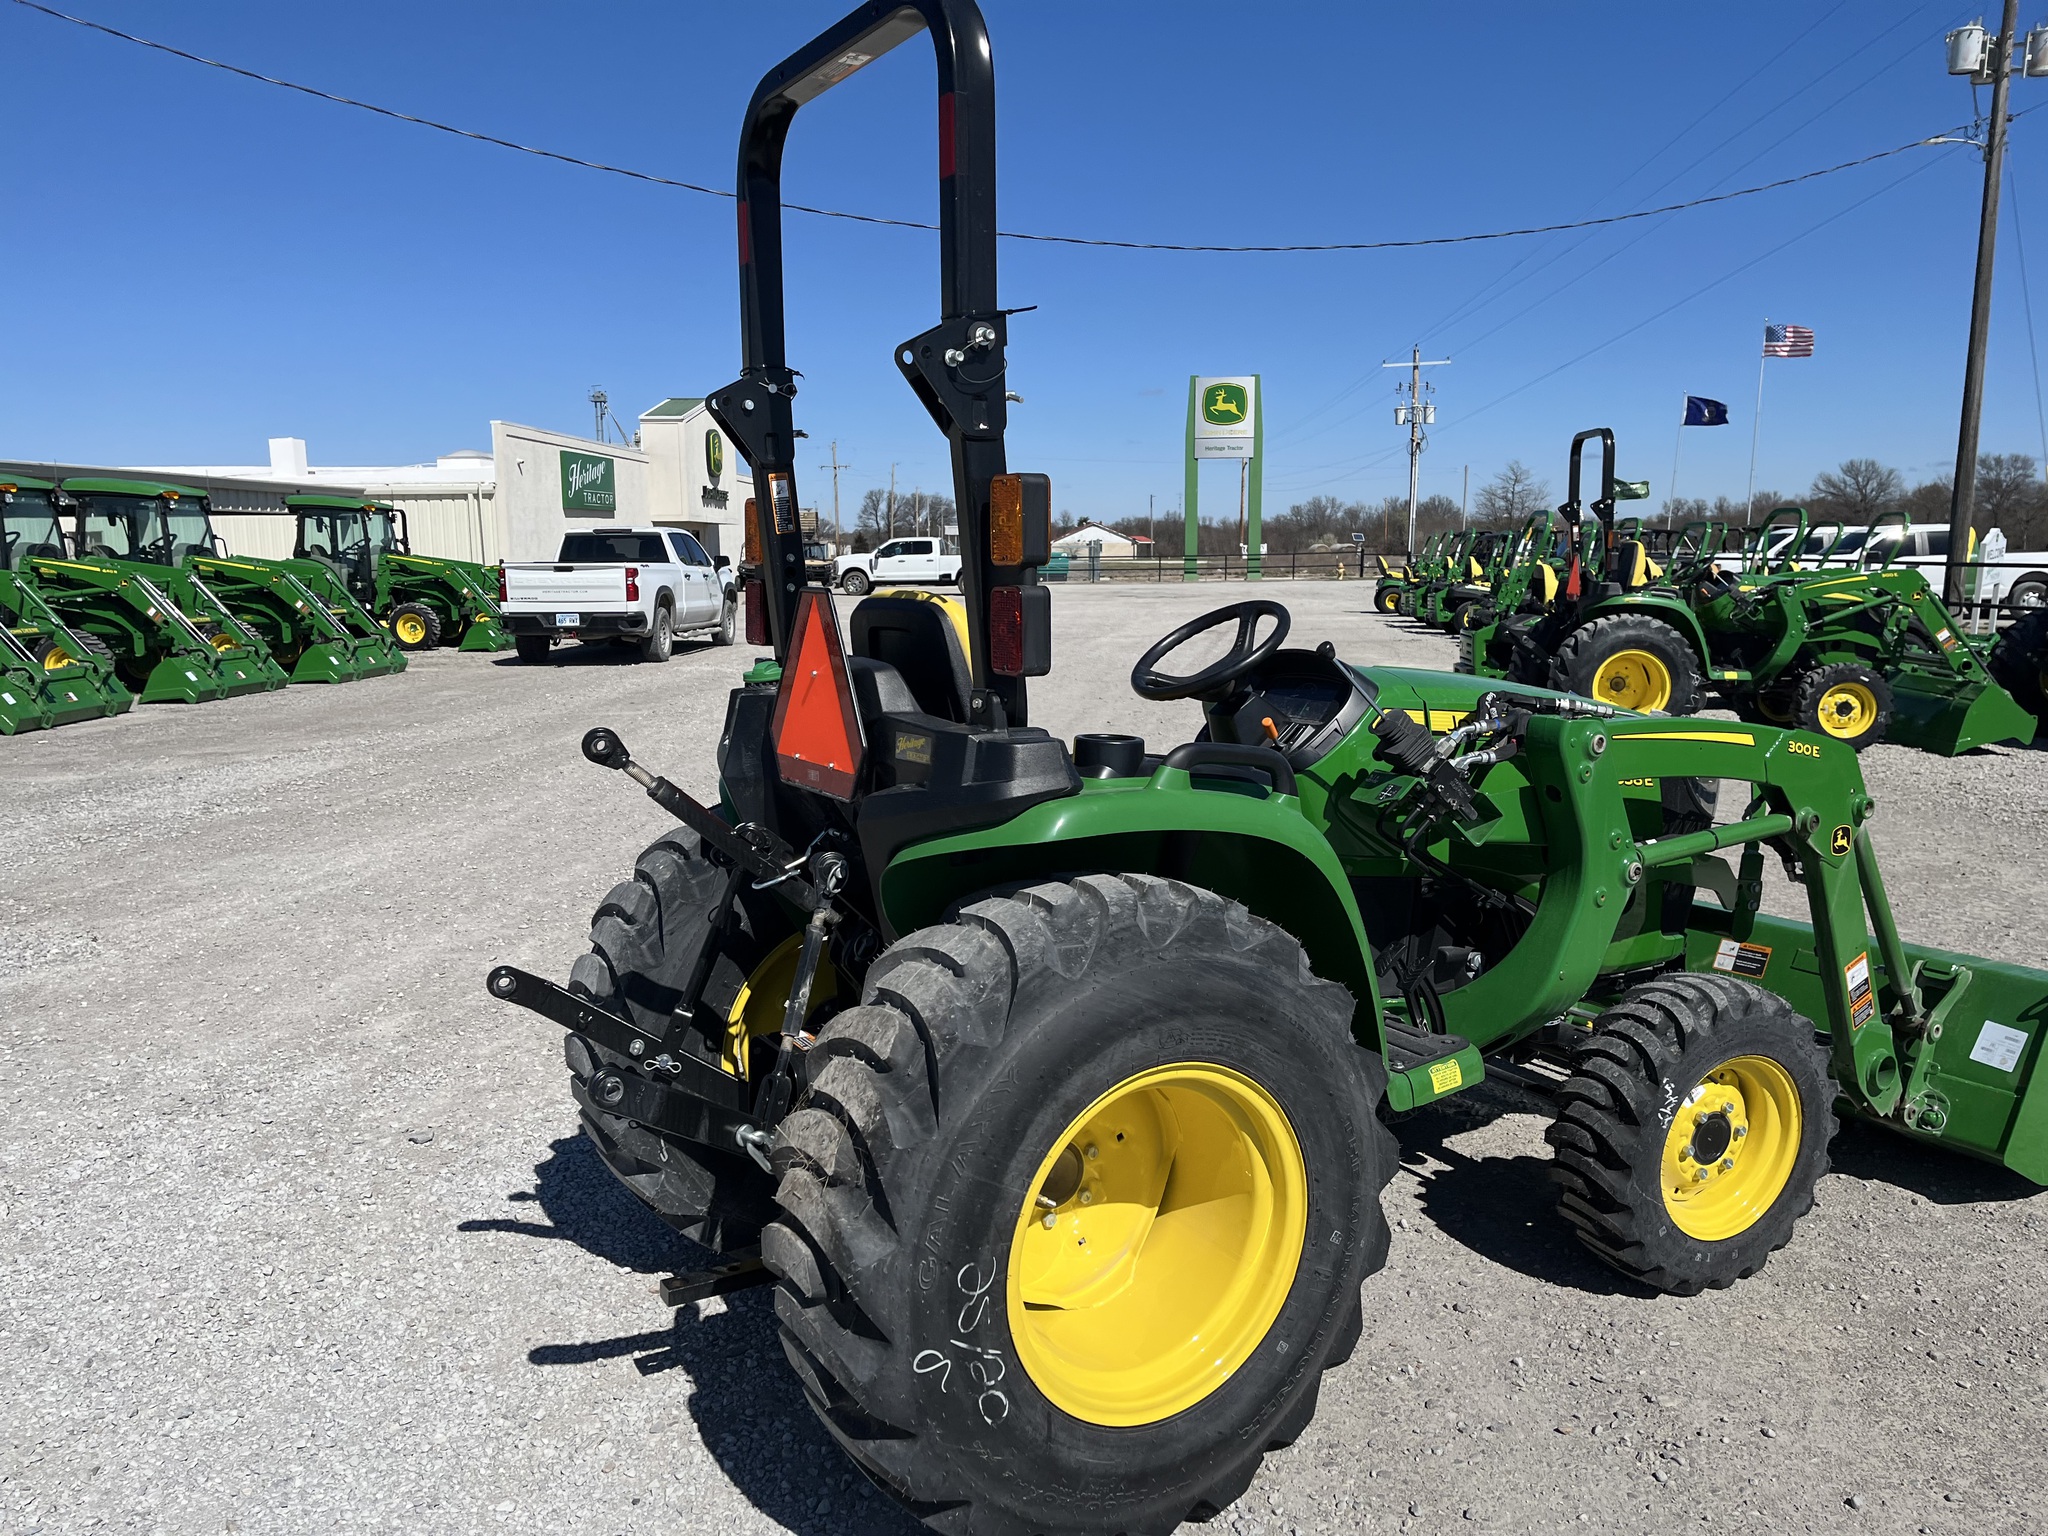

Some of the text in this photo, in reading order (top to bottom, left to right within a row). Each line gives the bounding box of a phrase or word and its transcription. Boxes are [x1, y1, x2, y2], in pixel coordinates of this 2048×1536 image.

[568, 459, 606, 498] Heritage
[583, 492, 614, 505] TRACTOR
[1986, 546, 2005, 560] WELCOME
[1788, 740, 1820, 758] 300E
